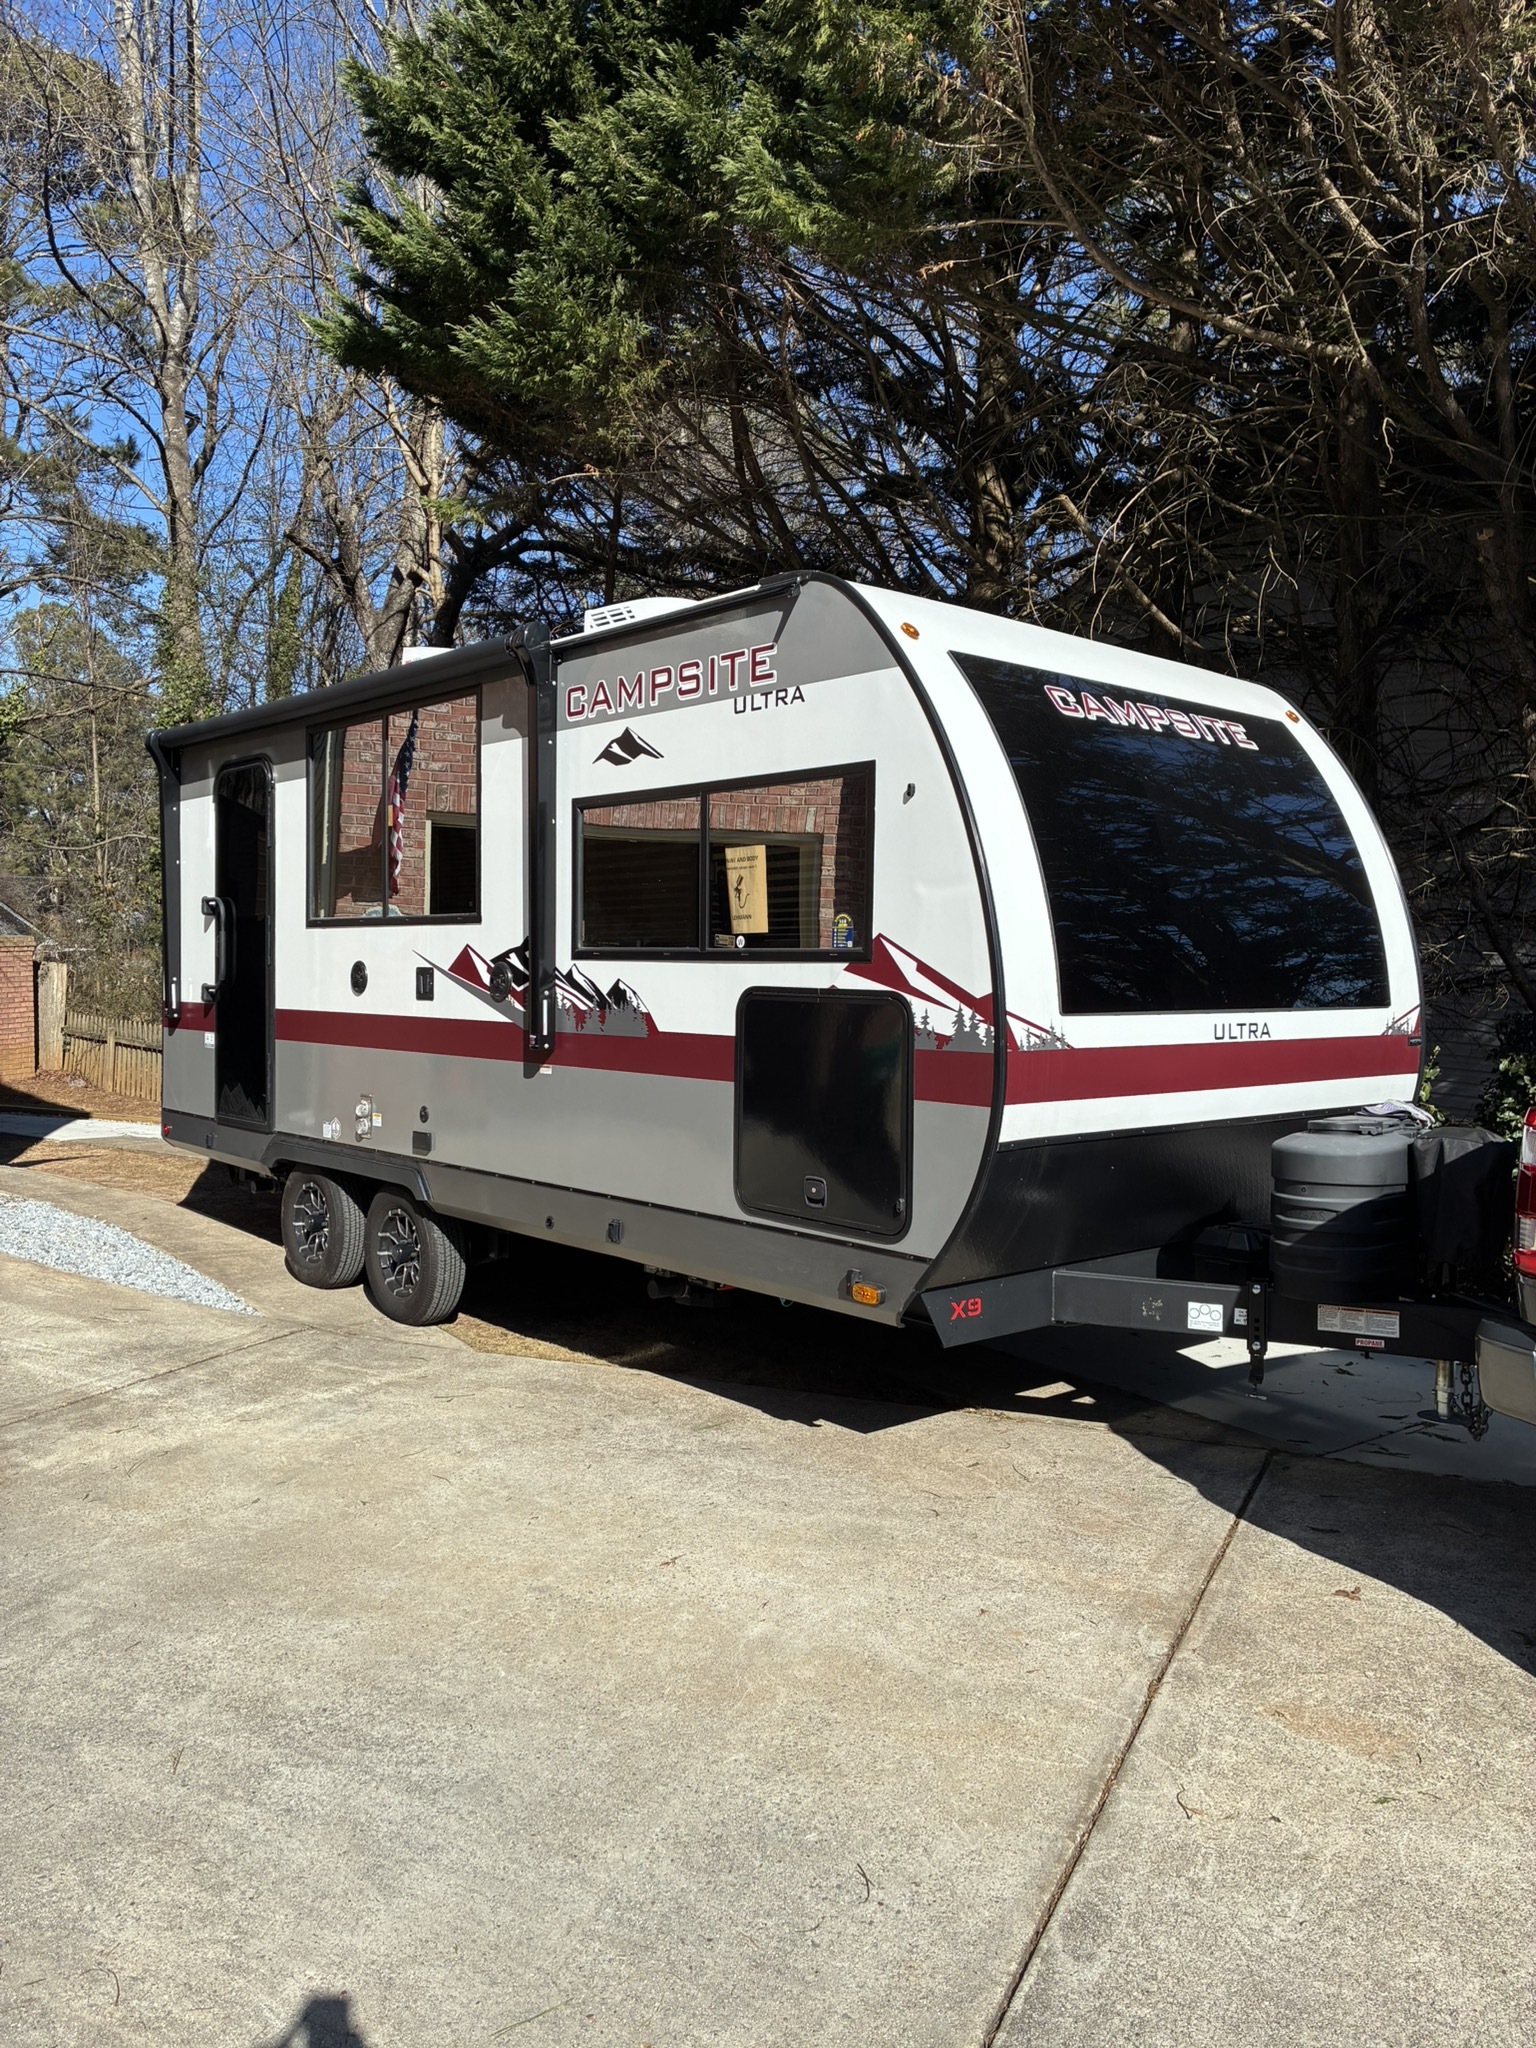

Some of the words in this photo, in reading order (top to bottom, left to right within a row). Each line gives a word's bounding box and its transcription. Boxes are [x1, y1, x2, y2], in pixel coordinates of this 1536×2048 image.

[566, 643, 777, 721] CAMPSITE
[734, 686, 806, 714] ULTRA
[1044, 685, 1259, 751] CAMPSITE
[1214, 1022, 1271, 1040] ULTRA
[951, 1297, 982, 1320] X9
